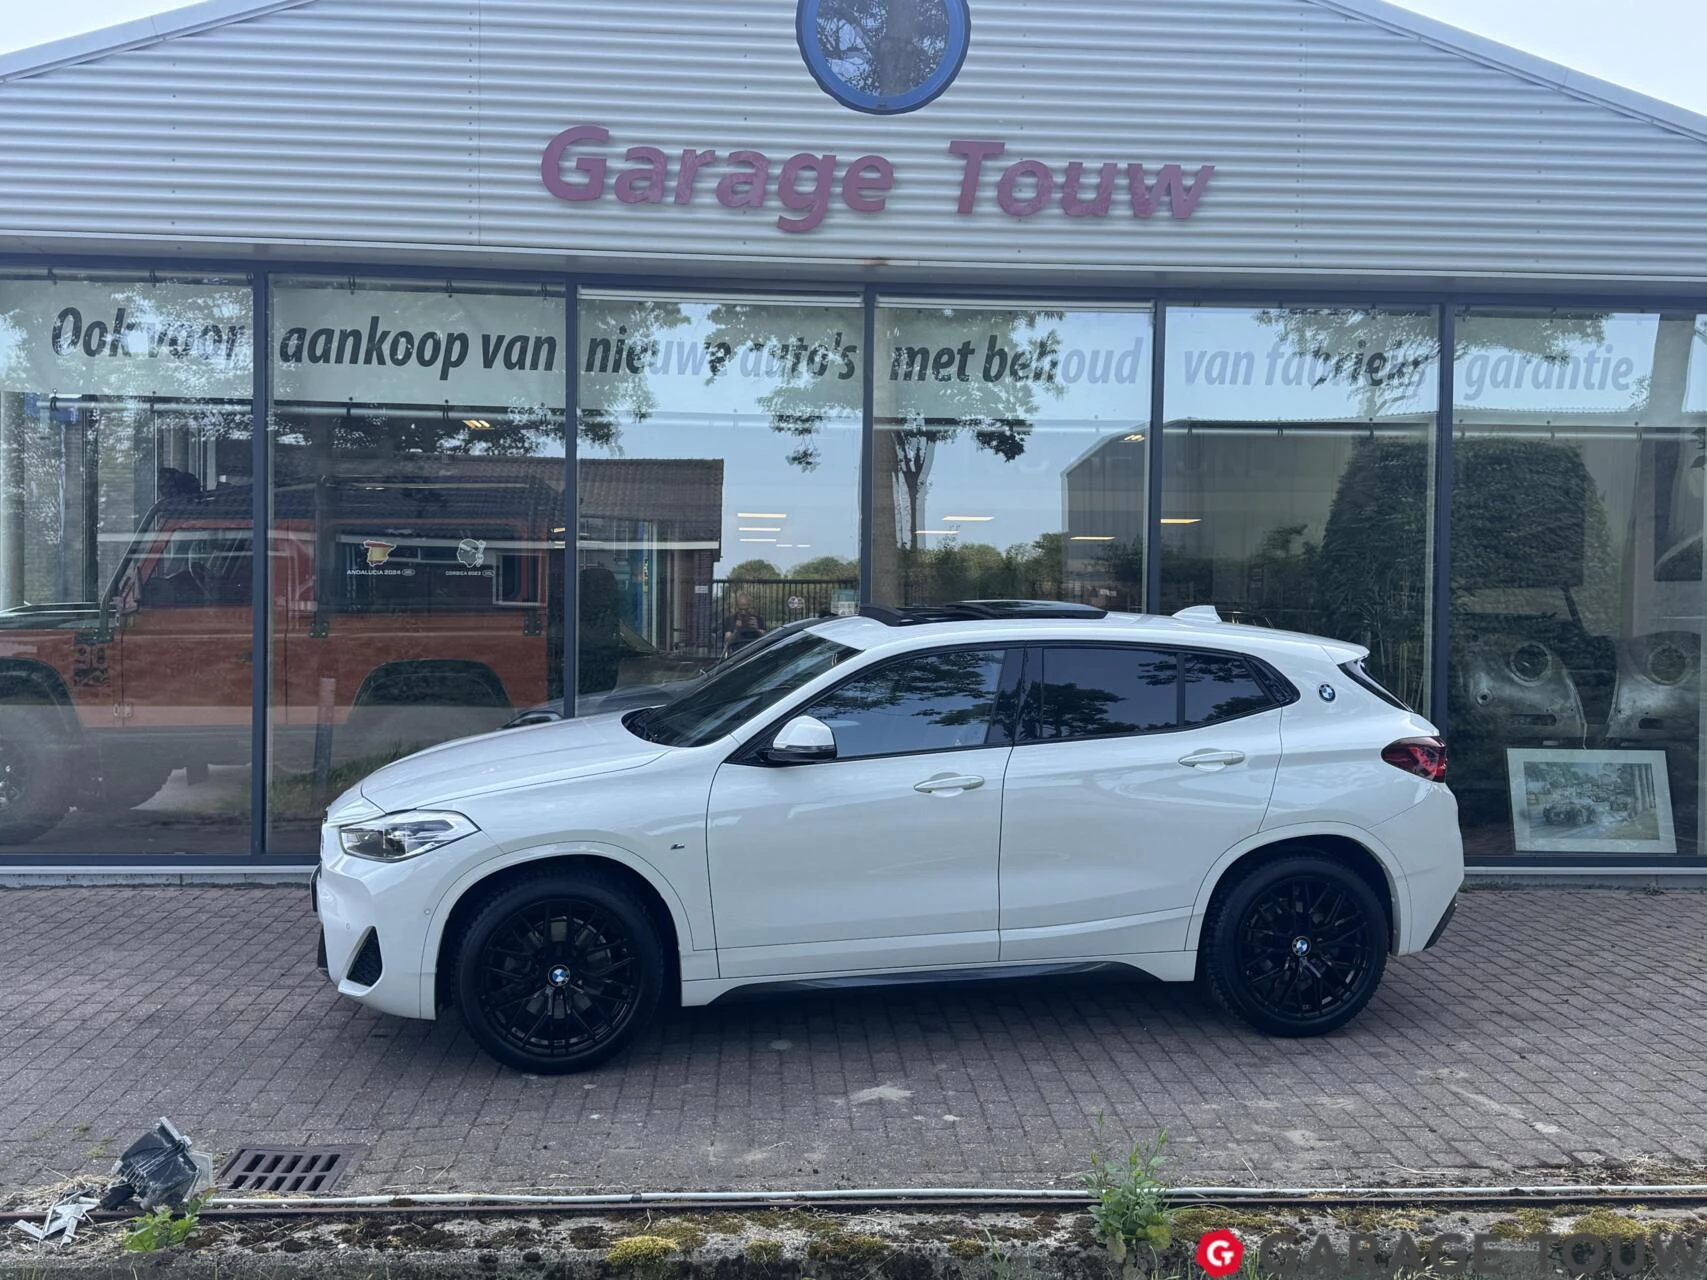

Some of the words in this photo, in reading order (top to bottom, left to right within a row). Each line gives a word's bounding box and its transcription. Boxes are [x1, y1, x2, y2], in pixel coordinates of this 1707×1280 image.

[540, 125, 895, 233] Garage
[948, 139, 1216, 219] Touw
[52, 307, 134, 358] Ook
[279, 315, 470, 381] aankoop
[481, 333, 558, 372] van
[584, 325, 732, 378] nieuwe
[739, 332, 858, 381] auto's
[889, 338, 976, 383] met
[982, 332, 1145, 386] behoud
[1183, 346, 1254, 386] van
[1464, 342, 1635, 402] garantie
